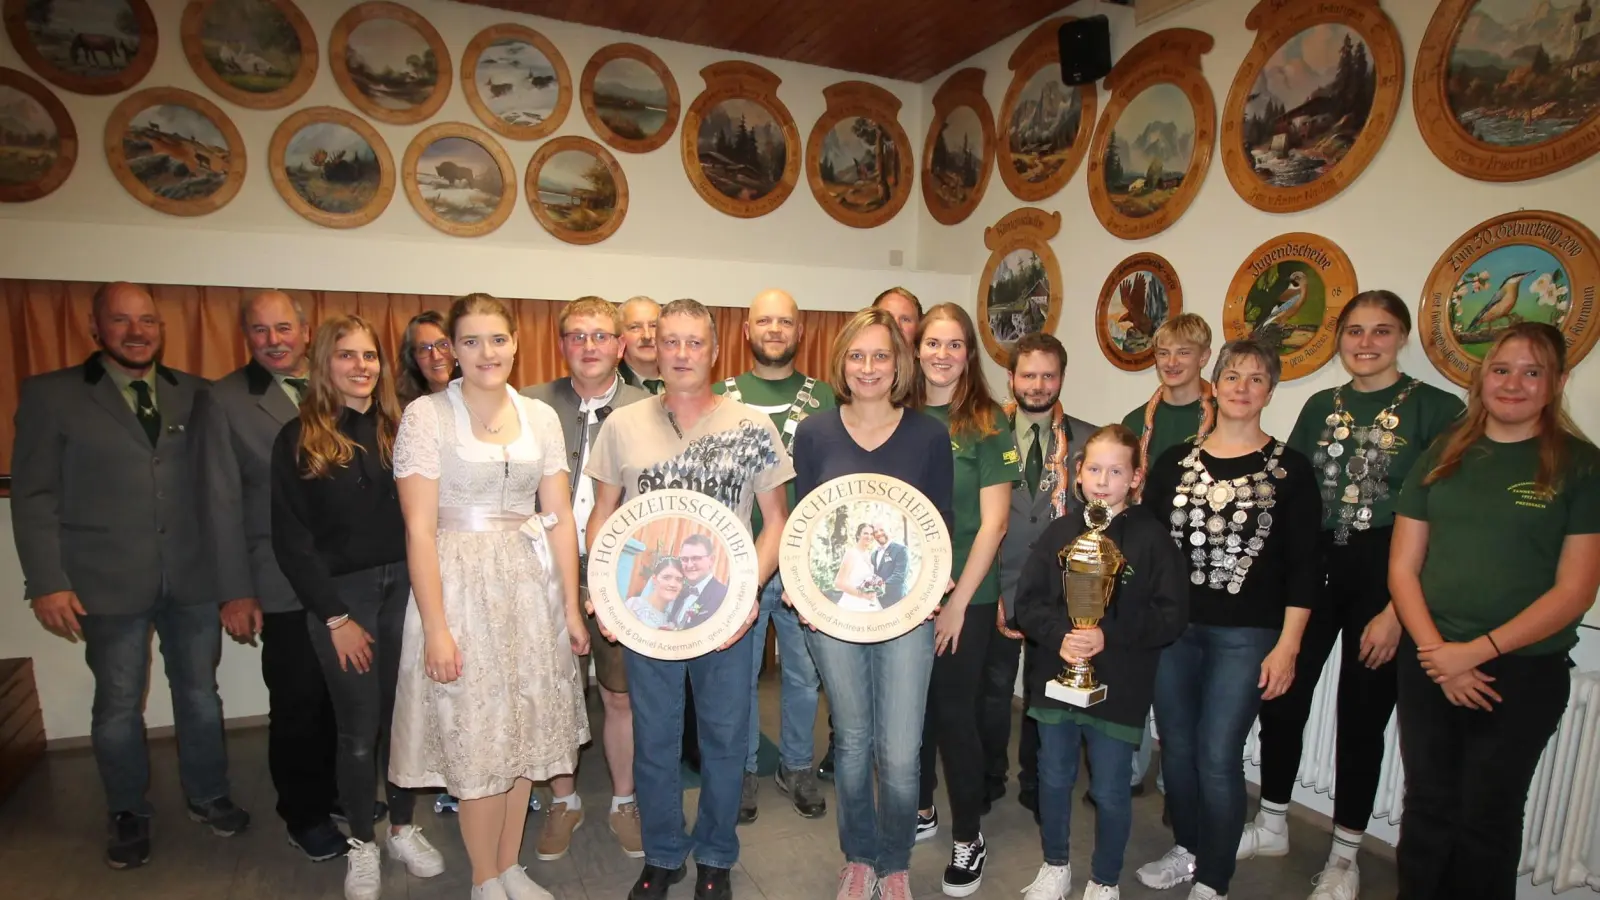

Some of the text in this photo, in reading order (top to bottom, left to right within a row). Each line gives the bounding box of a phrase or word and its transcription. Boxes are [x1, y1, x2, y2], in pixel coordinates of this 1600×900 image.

[1251, 241, 1331, 277] Jugendscheibe
[1448, 242, 1475, 272] Zum
[1495, 219, 1562, 247] Geburtstag
[595, 495, 749, 564] HOCHZEITSSCHEIBE
[786, 479, 941, 548] HOCHZEITSSCHEIBE
[817, 610, 832, 623] und
[832, 618, 865, 632] Andreas
[930, 554, 941, 583] Lehner
[608, 605, 626, 631] Renate
[625, 628, 632, 636] &
[631, 632, 657, 649] Daniel
[657, 638, 702, 652] Ackermann
